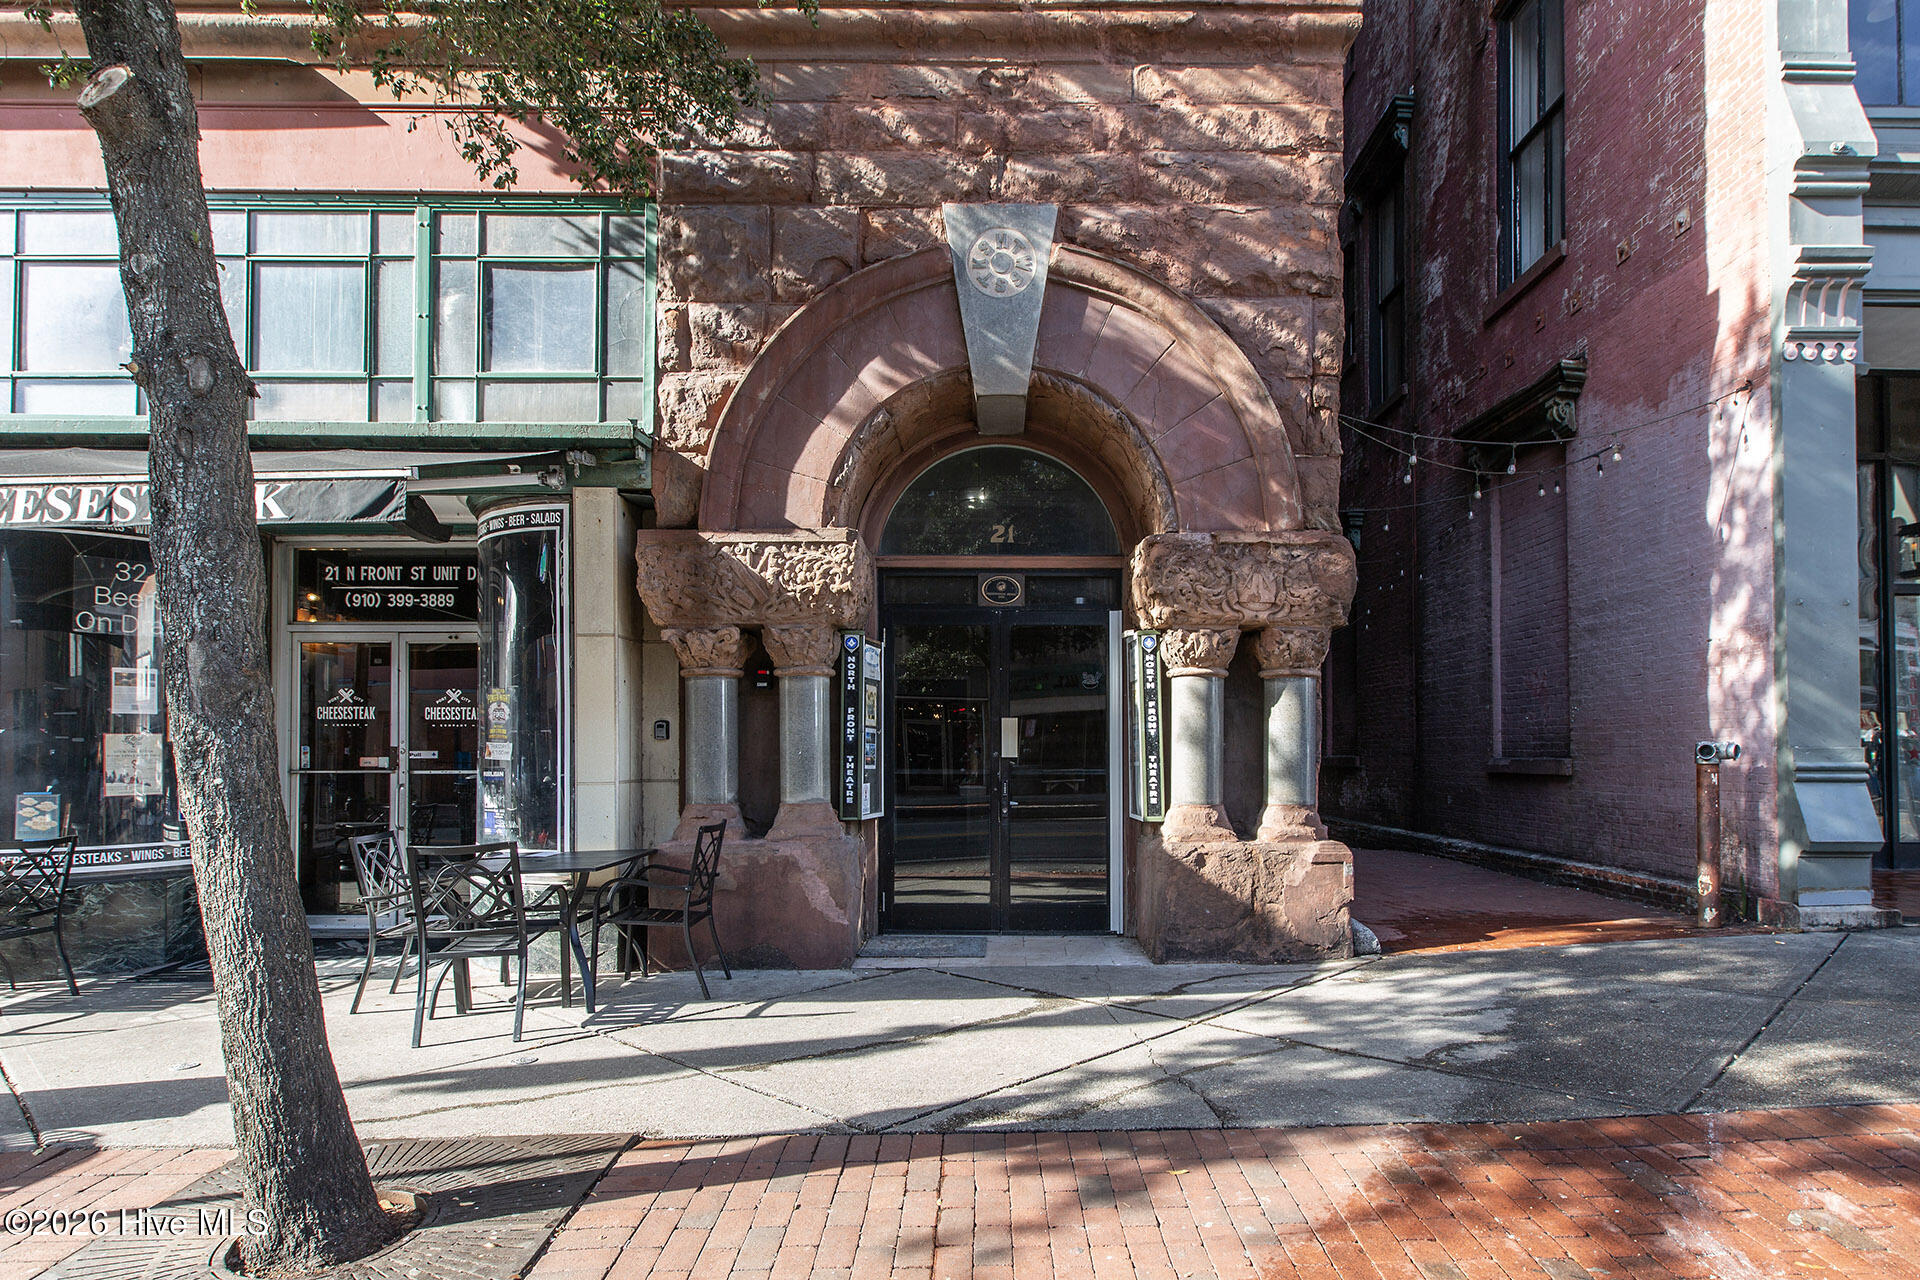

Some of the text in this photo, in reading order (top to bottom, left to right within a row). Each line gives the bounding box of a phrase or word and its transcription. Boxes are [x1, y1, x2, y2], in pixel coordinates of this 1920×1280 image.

[0, 484, 290, 524] ESESK
[509, 514, 525, 527] BEER
[530, 512, 561, 524] SALADS
[990, 525, 1015, 543] 21
[115, 562, 147, 583] 32
[325, 566, 477, 581] 21 N FRONT ST UNIT D
[345, 592, 455, 608] (910) 399-3889
[76, 611, 112, 632] On
[317, 706, 376, 720] CHEESESTEAK
[425, 706, 479, 720] CHEESESTEA
[846, 656, 855, 804] NORTH FRONT THEATRE
[1145, 654, 1158, 804] NORTH FRONT THEATRE
[131, 848, 165, 861] WINGS
[173, 847, 191, 858] BEE
